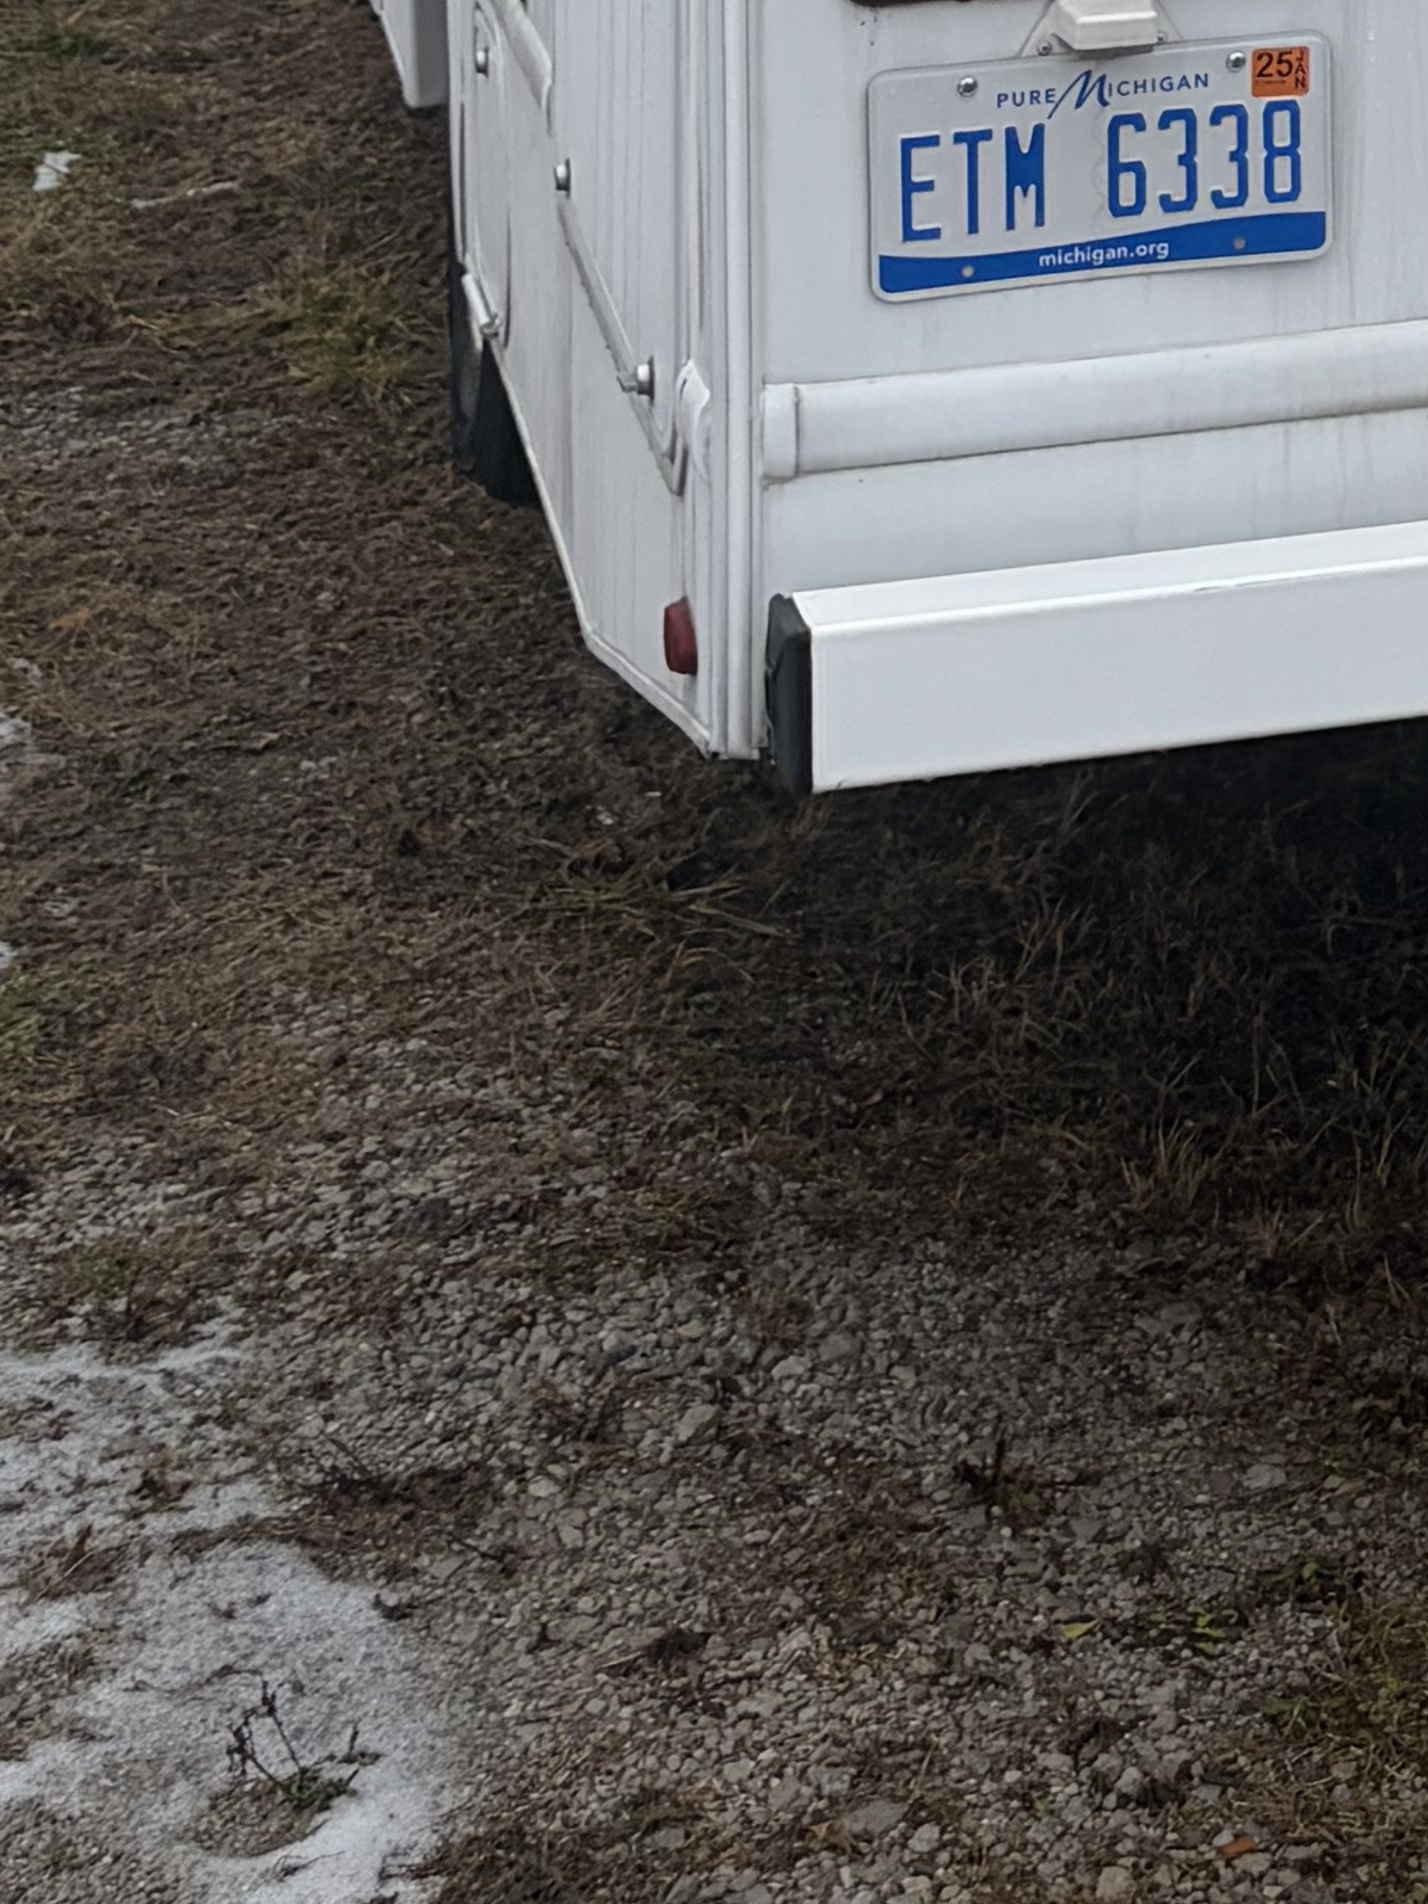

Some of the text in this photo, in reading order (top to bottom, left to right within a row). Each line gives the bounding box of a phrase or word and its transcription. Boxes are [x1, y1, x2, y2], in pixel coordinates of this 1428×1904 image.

[1256, 51, 1293, 78] 25
[1295, 49, 1307, 89] JAN
[997, 69, 1209, 120] PURE MICHIGAN
[900, 99, 1301, 243] ETM 6338
[1039, 241, 1170, 268] michigan.org
